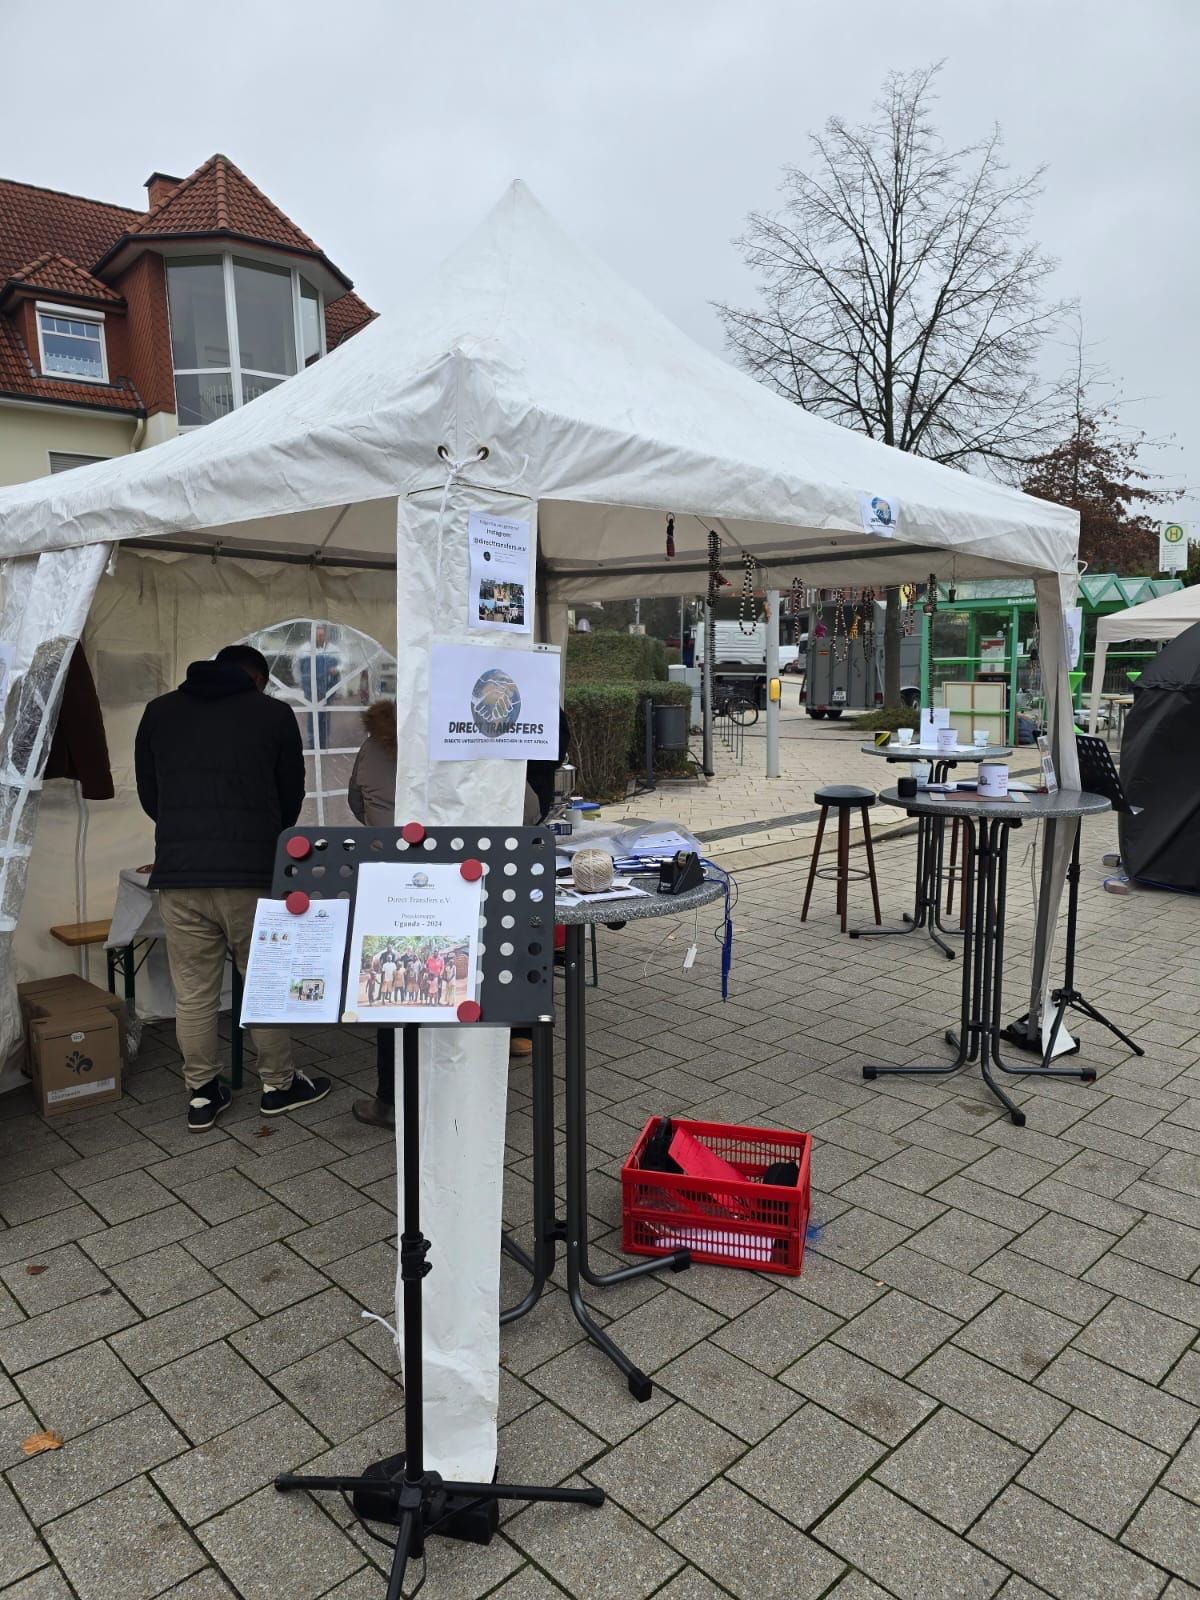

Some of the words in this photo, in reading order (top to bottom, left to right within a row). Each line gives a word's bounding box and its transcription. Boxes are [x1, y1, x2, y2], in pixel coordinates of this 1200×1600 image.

[449, 721, 482, 733] DIRECT
[486, 722, 544, 735] TRANSFERS
[410, 896, 438, 904] Transfers
